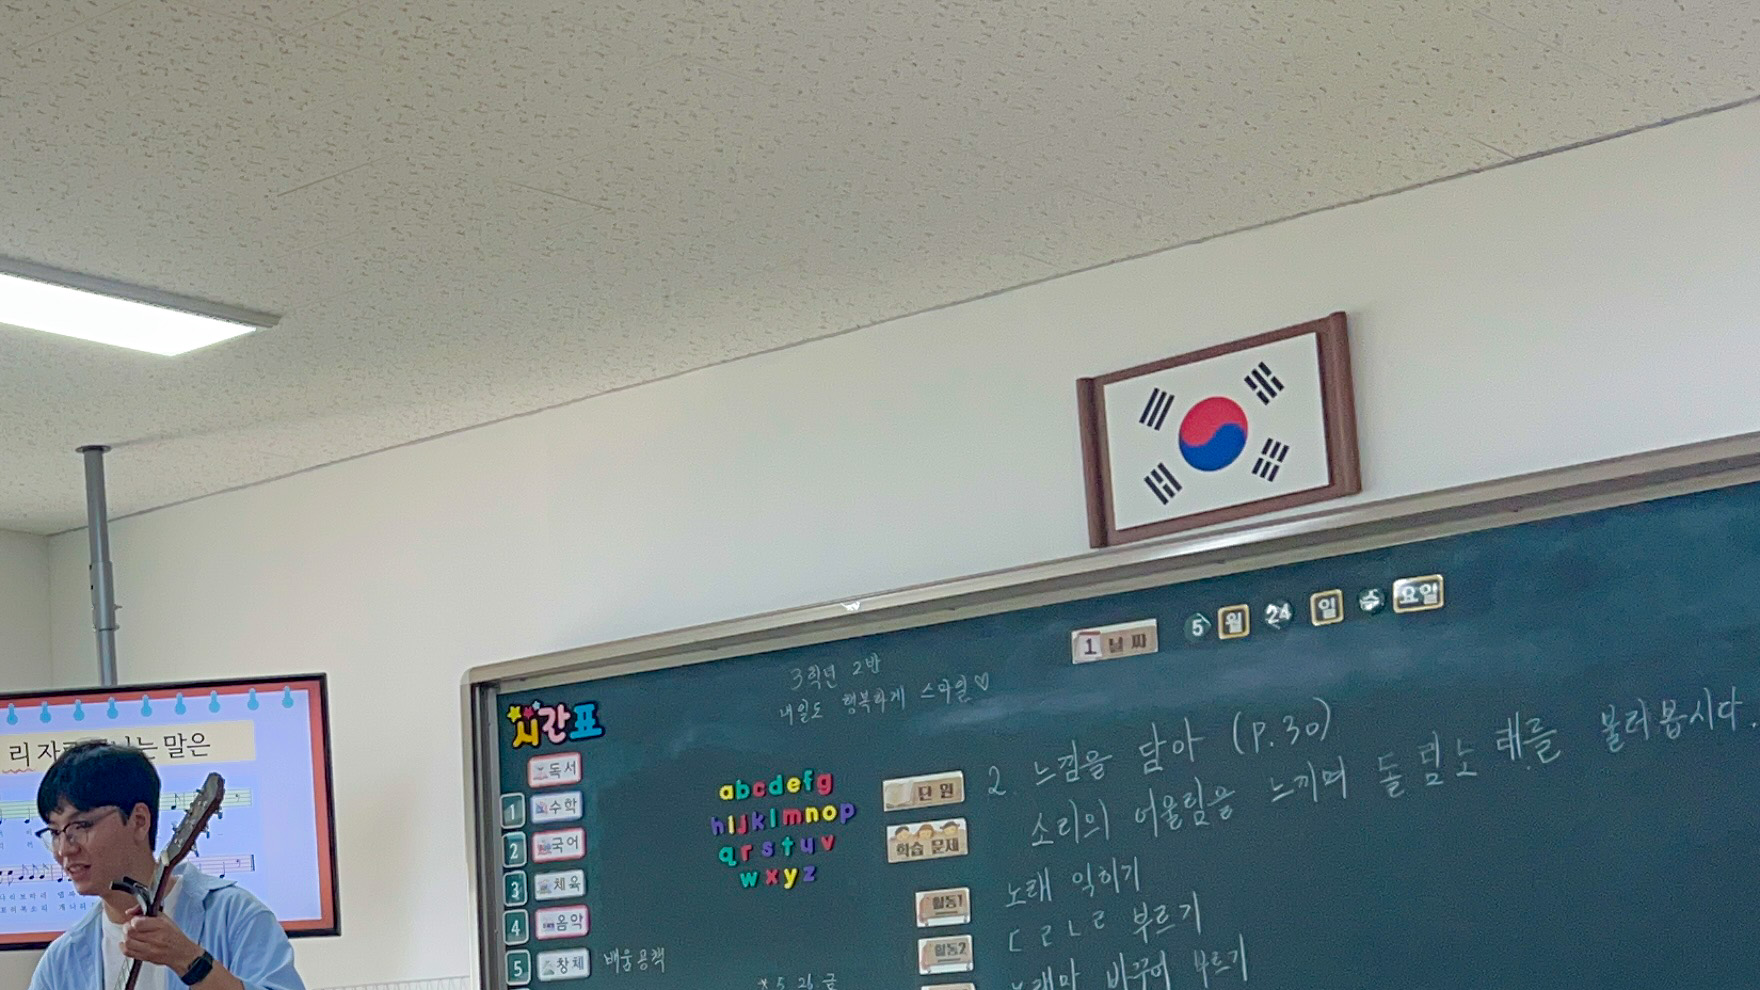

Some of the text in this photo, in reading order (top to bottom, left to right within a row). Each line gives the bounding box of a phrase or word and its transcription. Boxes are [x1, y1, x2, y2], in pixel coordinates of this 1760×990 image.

[1192, 619, 1204, 637] 5
[1266, 601, 1292, 625] 24
[1318, 597, 1336, 619] 일
[1399, 582, 1438, 605] 요일
[852, 652, 881, 676] 2반
[779, 698, 823, 726] 내일도
[842, 685, 905, 714] 행복하게
[512, 703, 603, 748] 시간표
[9, 742, 30, 767] 리
[163, 732, 211, 759] 말은
[1034, 740, 1114, 785] 느낌을
[1139, 716, 1205, 775] 담아
[549, 760, 576, 778] 독서
[719, 769, 833, 800] abcdefg
[549, 798, 577, 814] 수학
[1031, 798, 1110, 847] 소리의
[1135, 776, 1236, 838] 어울림을
[1270, 755, 1347, 803] 느끼며
[510, 835, 578, 860] 2 국어
[511, 875, 581, 900] 3 체육
[1005, 856, 1140, 908] 노래 익히기
[511, 920, 520, 936] 4
[1133, 890, 1202, 944] 부르기
[513, 956, 584, 977] 5 창체
[1194, 933, 1248, 989] 부르기
